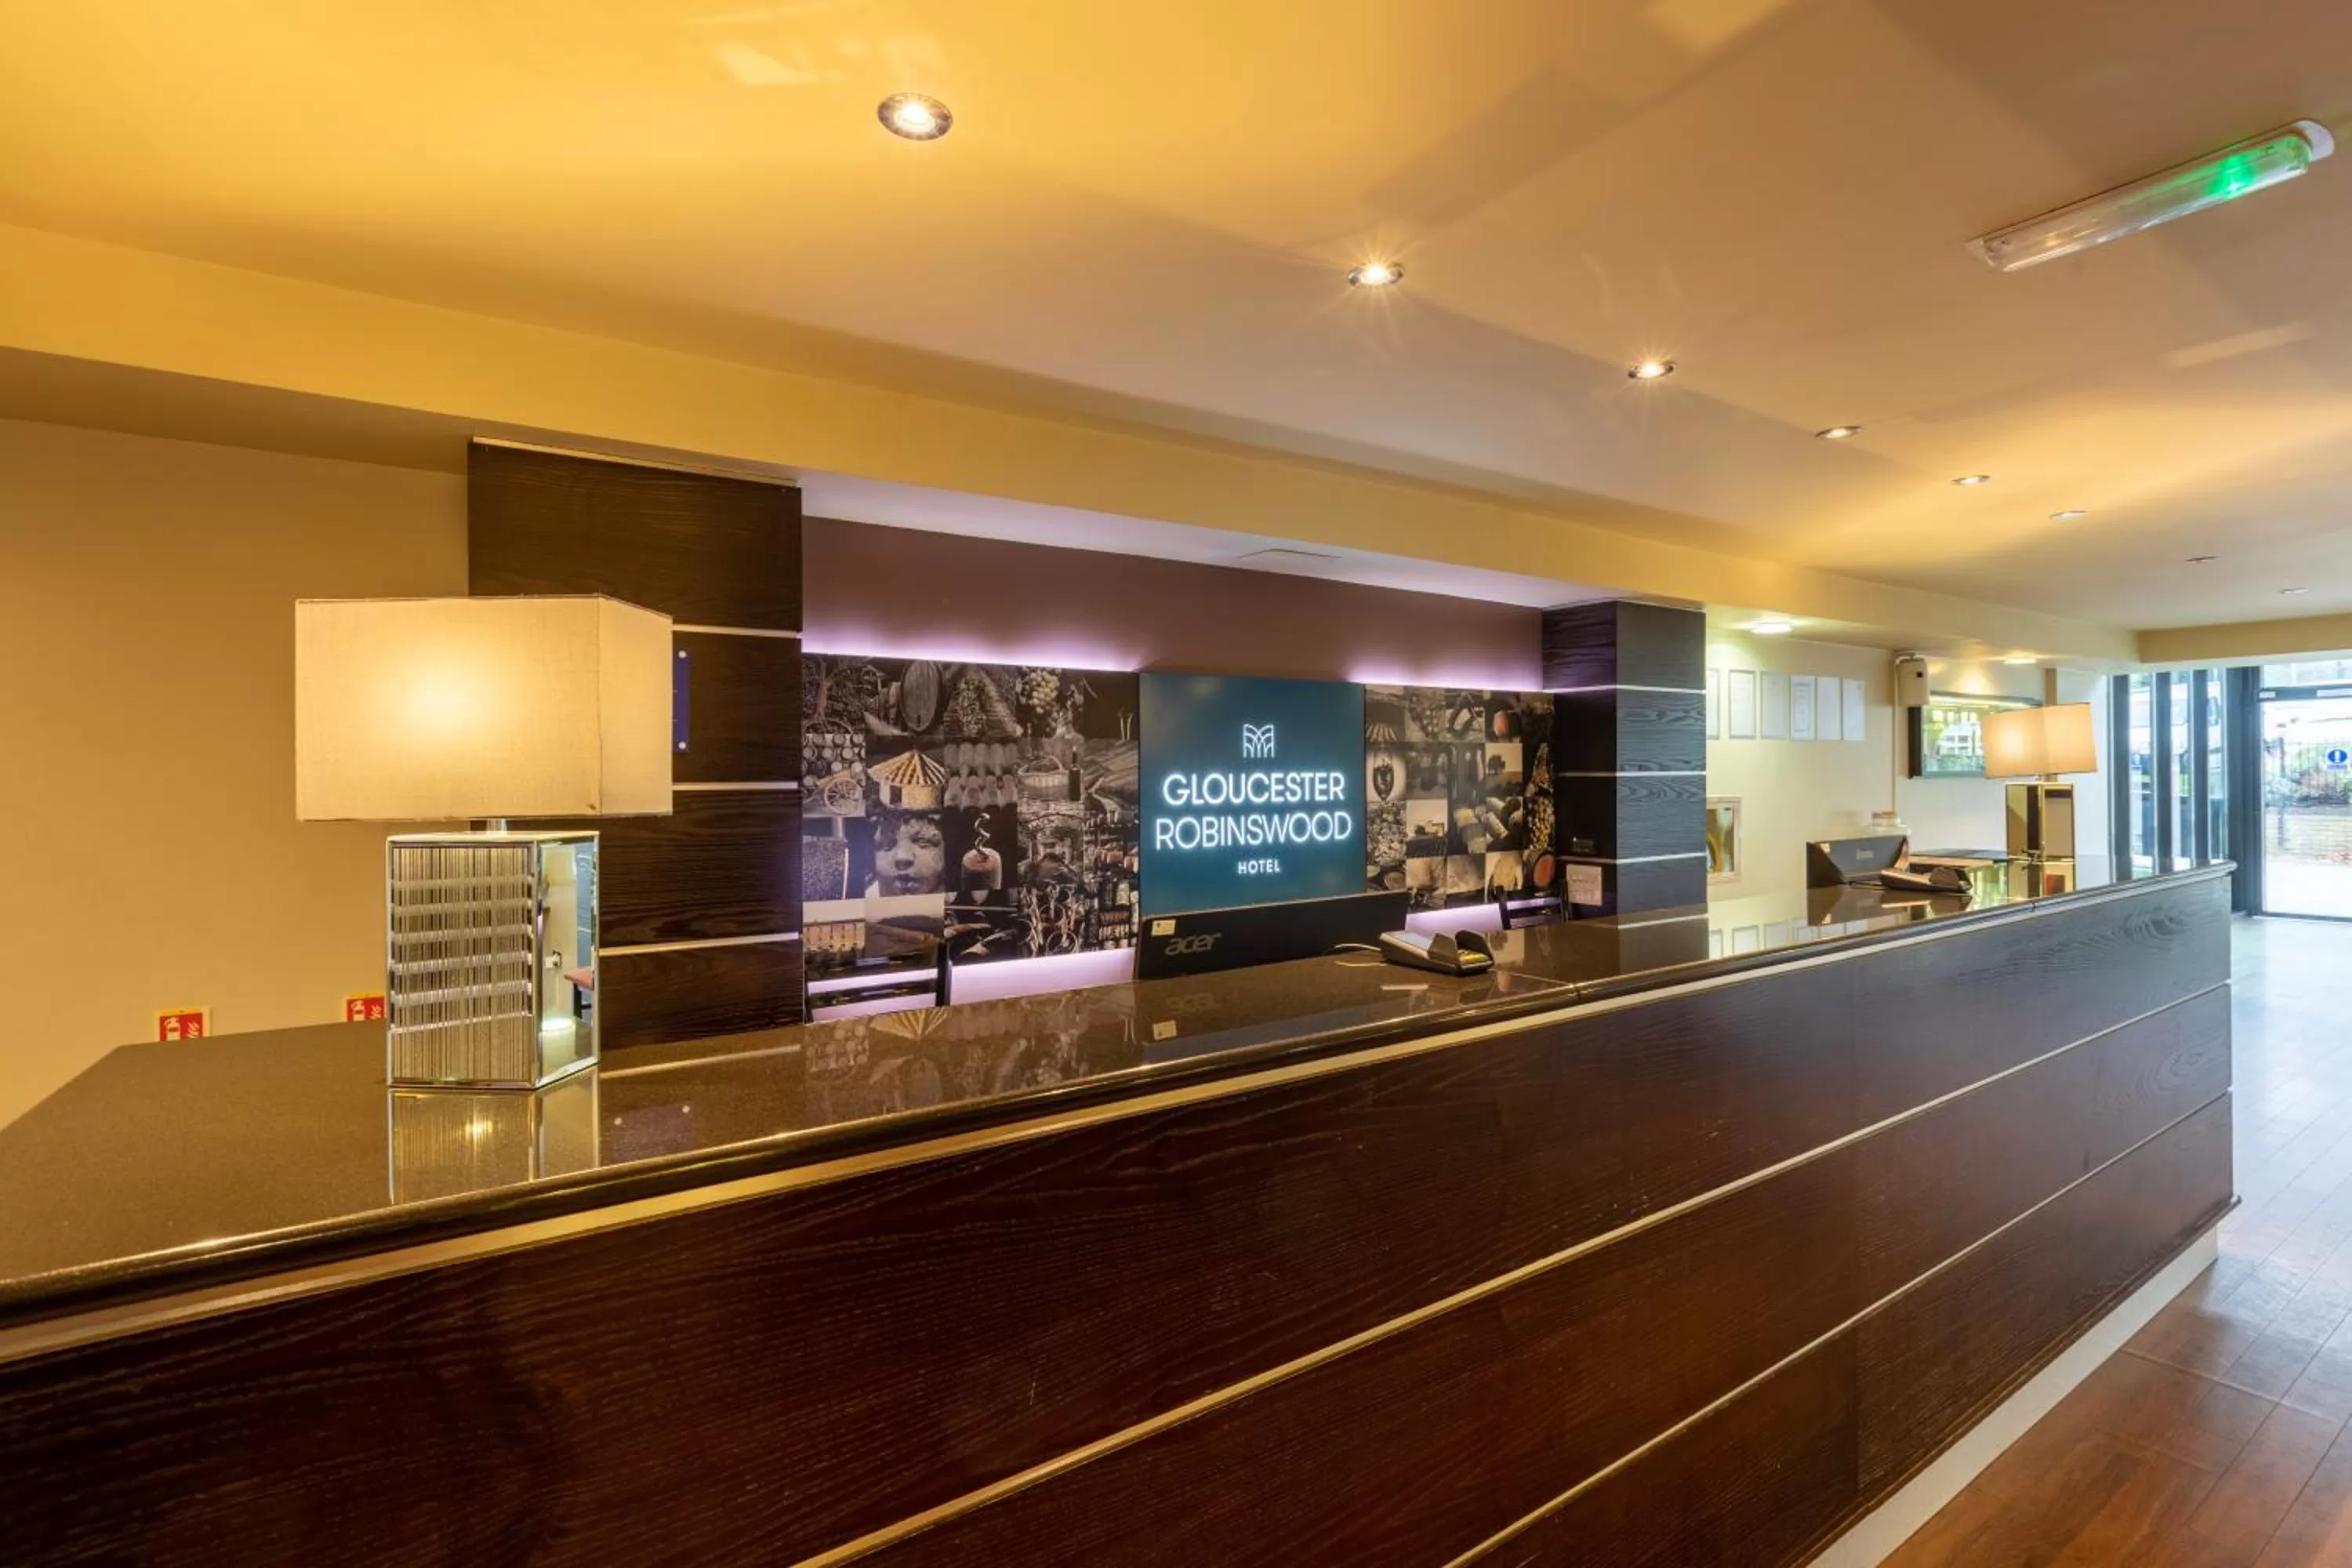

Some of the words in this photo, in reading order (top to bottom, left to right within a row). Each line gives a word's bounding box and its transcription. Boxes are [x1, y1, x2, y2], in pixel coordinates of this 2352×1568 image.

[1163, 772, 1345, 806] GLOUCESTER
[1156, 811, 1352, 850] ROBINSWOOD
[1237, 859, 1280, 874] HOTEL
[1165, 933, 1221, 956] acer
